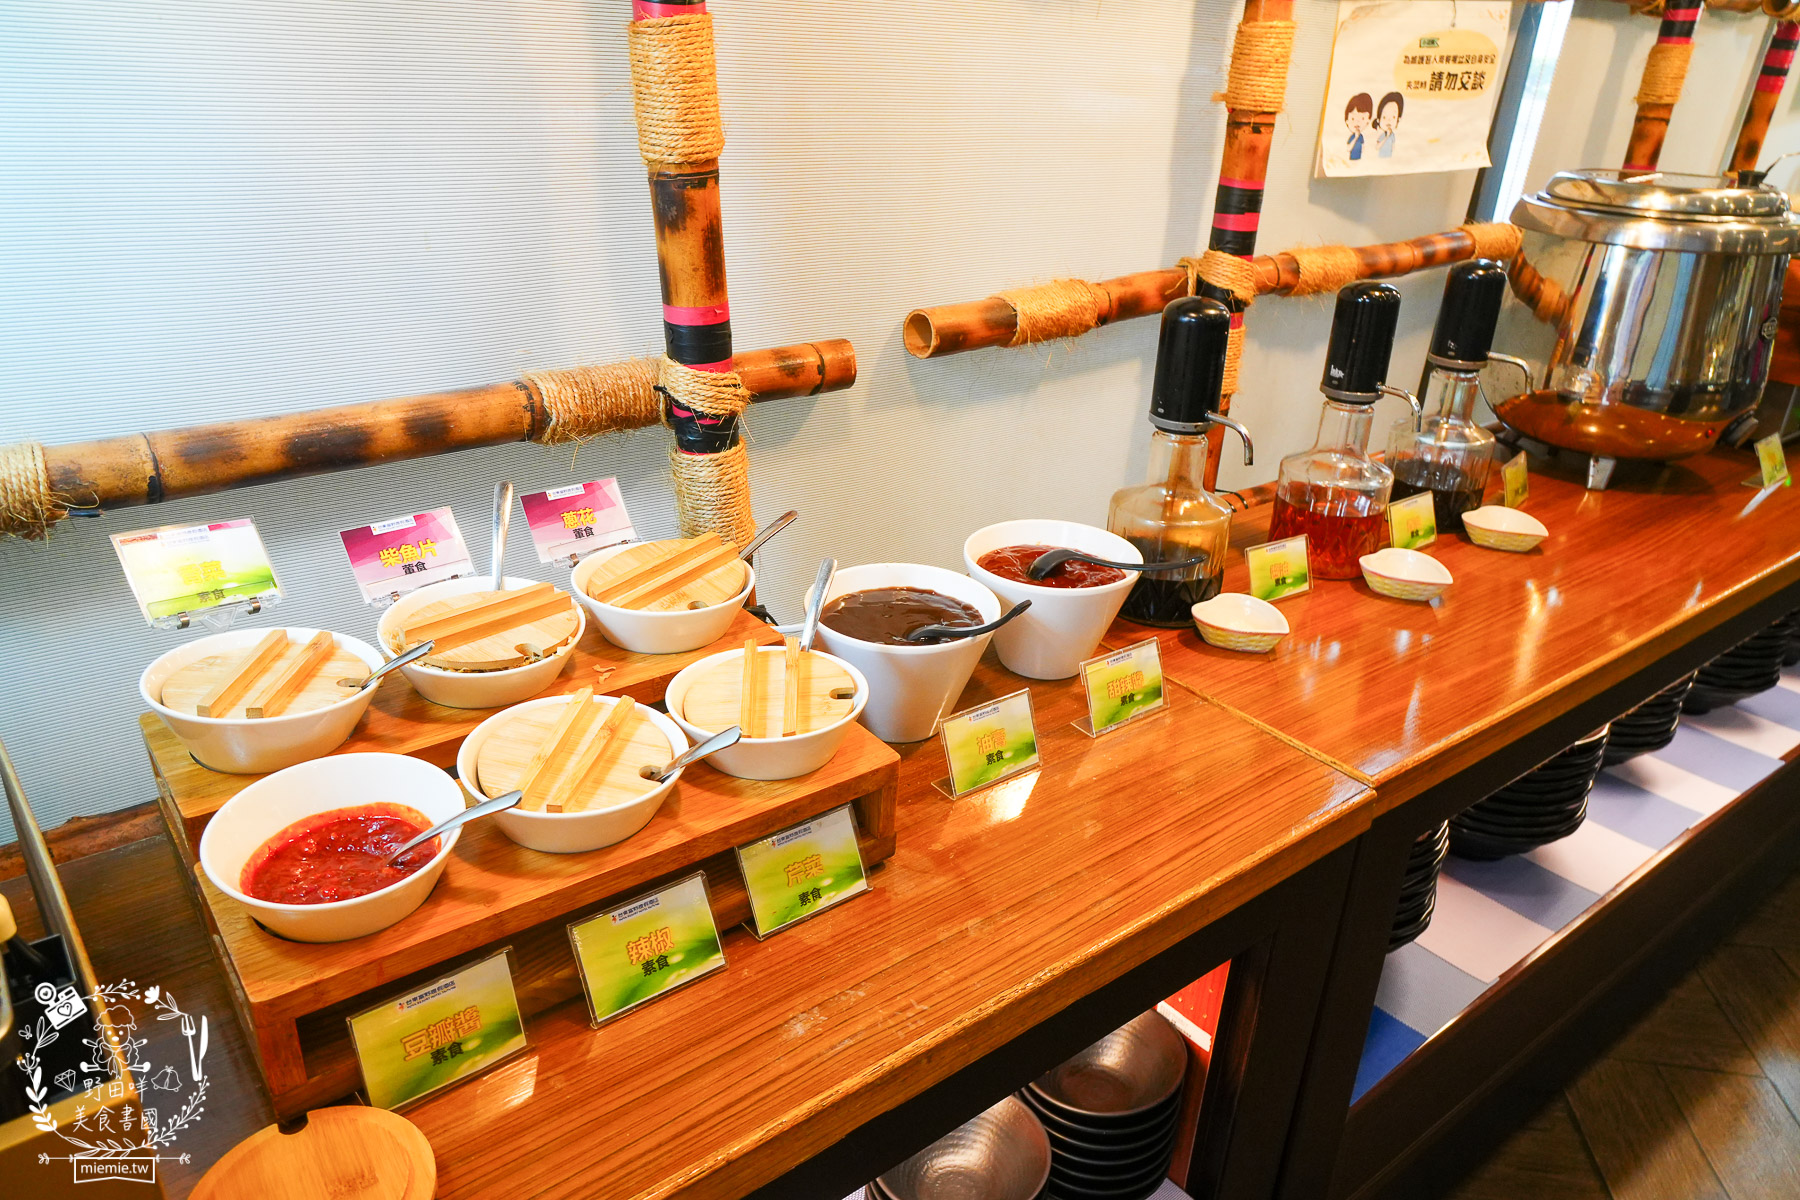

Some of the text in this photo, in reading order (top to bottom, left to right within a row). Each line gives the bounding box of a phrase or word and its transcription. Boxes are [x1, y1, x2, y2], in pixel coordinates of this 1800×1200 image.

[1429, 70, 1487, 92] 請勿交談
[560, 506, 597, 529] 蔥花
[572, 525, 595, 539] 葷食
[378, 537, 438, 568] 柴魚片
[401, 560, 428, 575] 葷食
[197, 588, 226, 603] 素食
[1107, 670, 1145, 699] 甜辣醬
[1120, 692, 1136, 706] 素食
[976, 727, 1007, 755] 油膏
[985, 749, 1004, 766] 素食
[784, 854, 825, 887] 芹菜
[798, 886, 823, 907] 素食
[626, 926, 675, 966] 辣椒
[641, 953, 670, 977] 素食
[400, 1005, 483, 1062] 豆瓣醬
[430, 1041, 464, 1066] 素食
